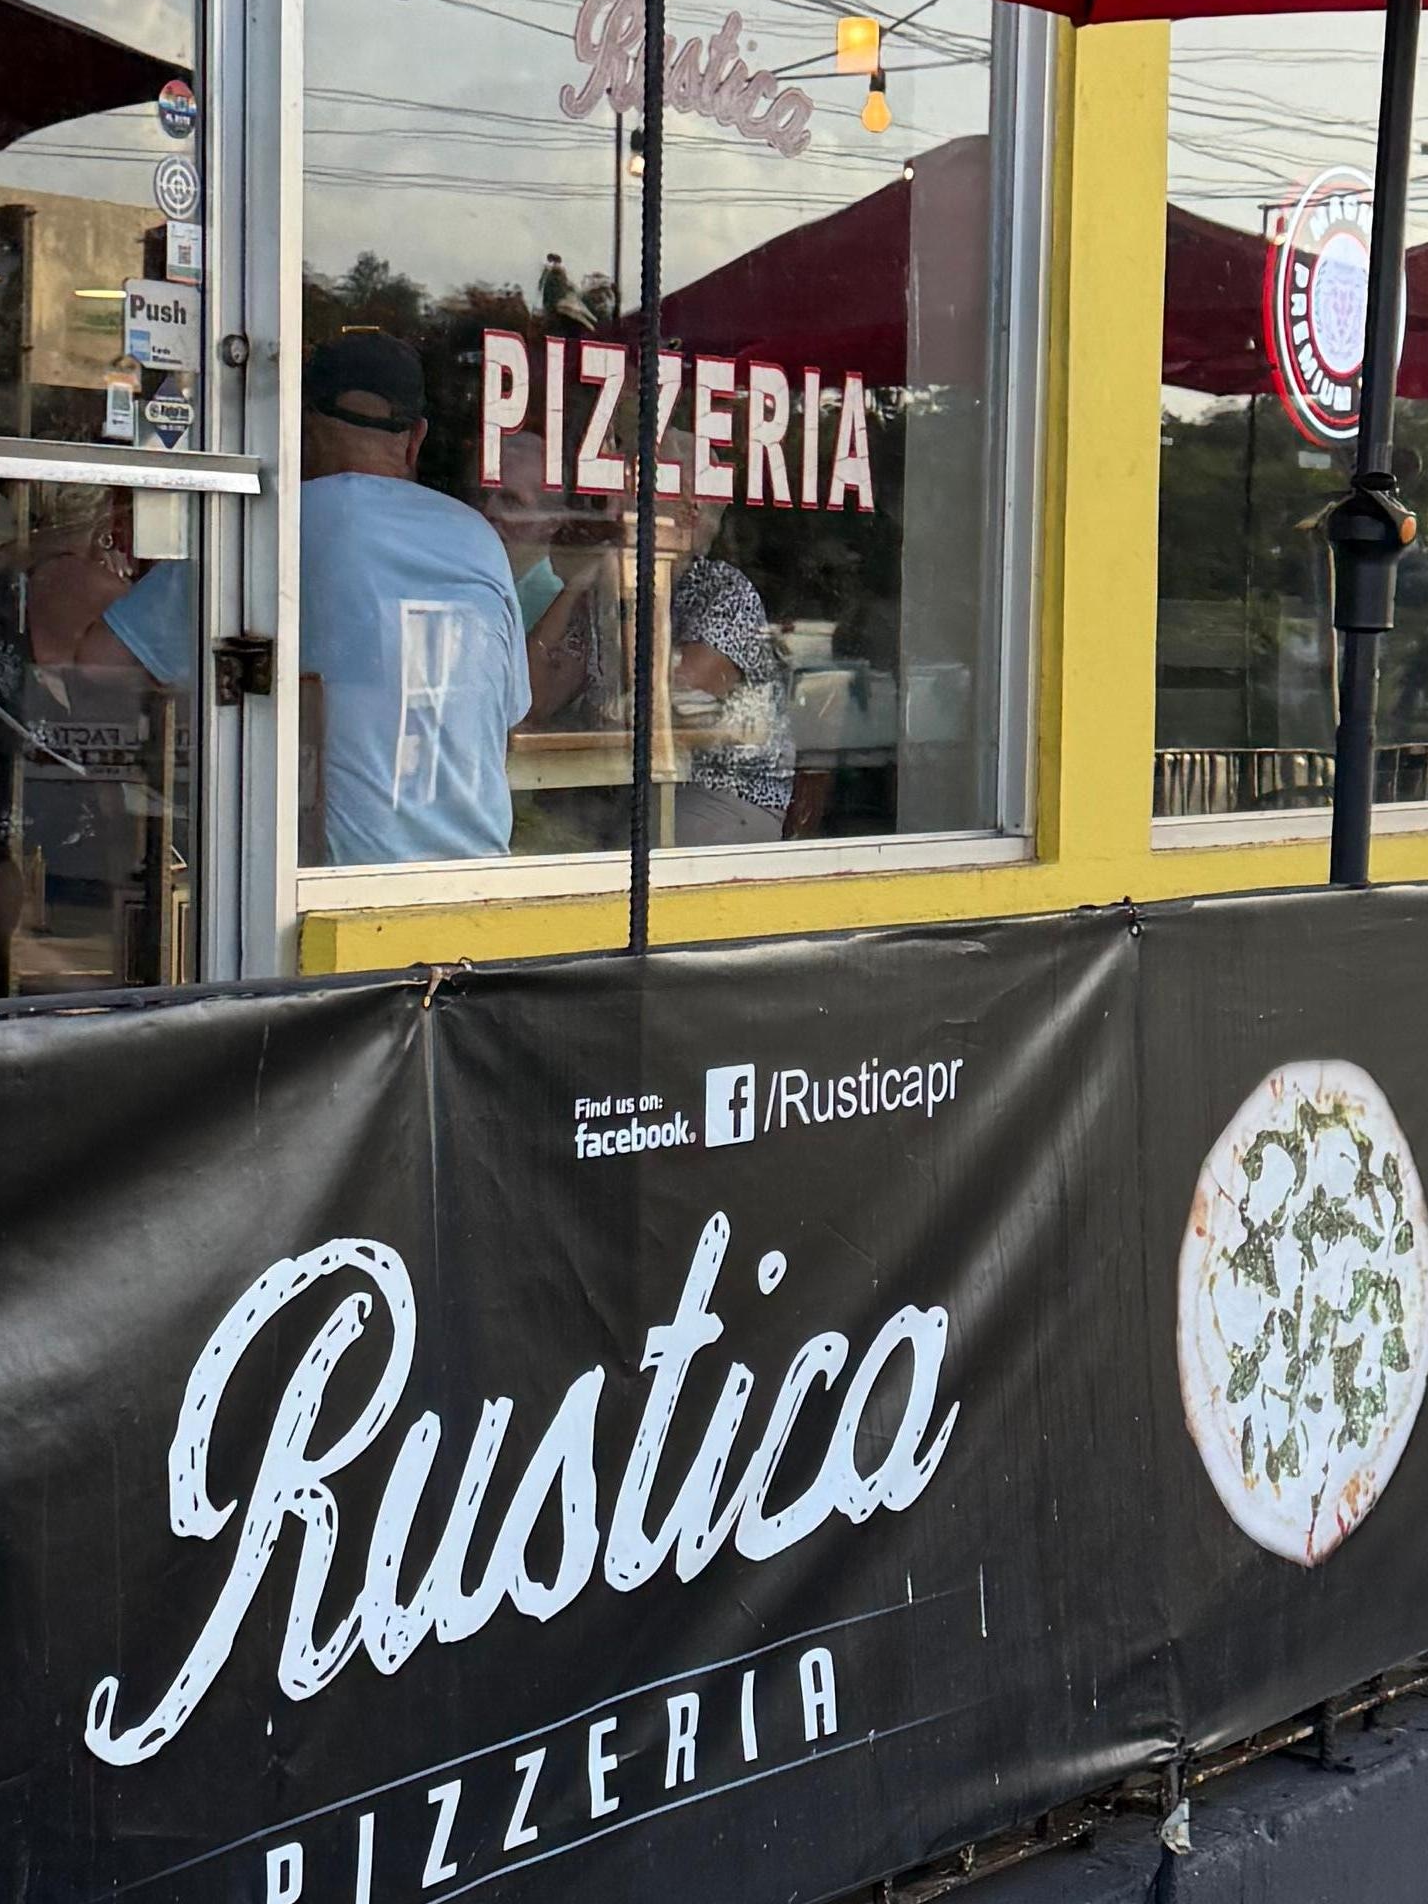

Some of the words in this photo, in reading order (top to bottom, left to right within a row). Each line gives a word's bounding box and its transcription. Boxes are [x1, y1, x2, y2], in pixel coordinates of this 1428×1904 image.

[130, 294, 186, 325] Push
[1290, 262, 1352, 412] PREMIUM
[480, 328, 874, 512] PIZZERIA
[574, 1094, 611, 1120] Find
[615, 1097, 635, 1114] us
[638, 1094, 664, 1112] on:
[763, 1057, 964, 1133] /Rusticapr
[84, 1210, 961, 1767] Rustica
